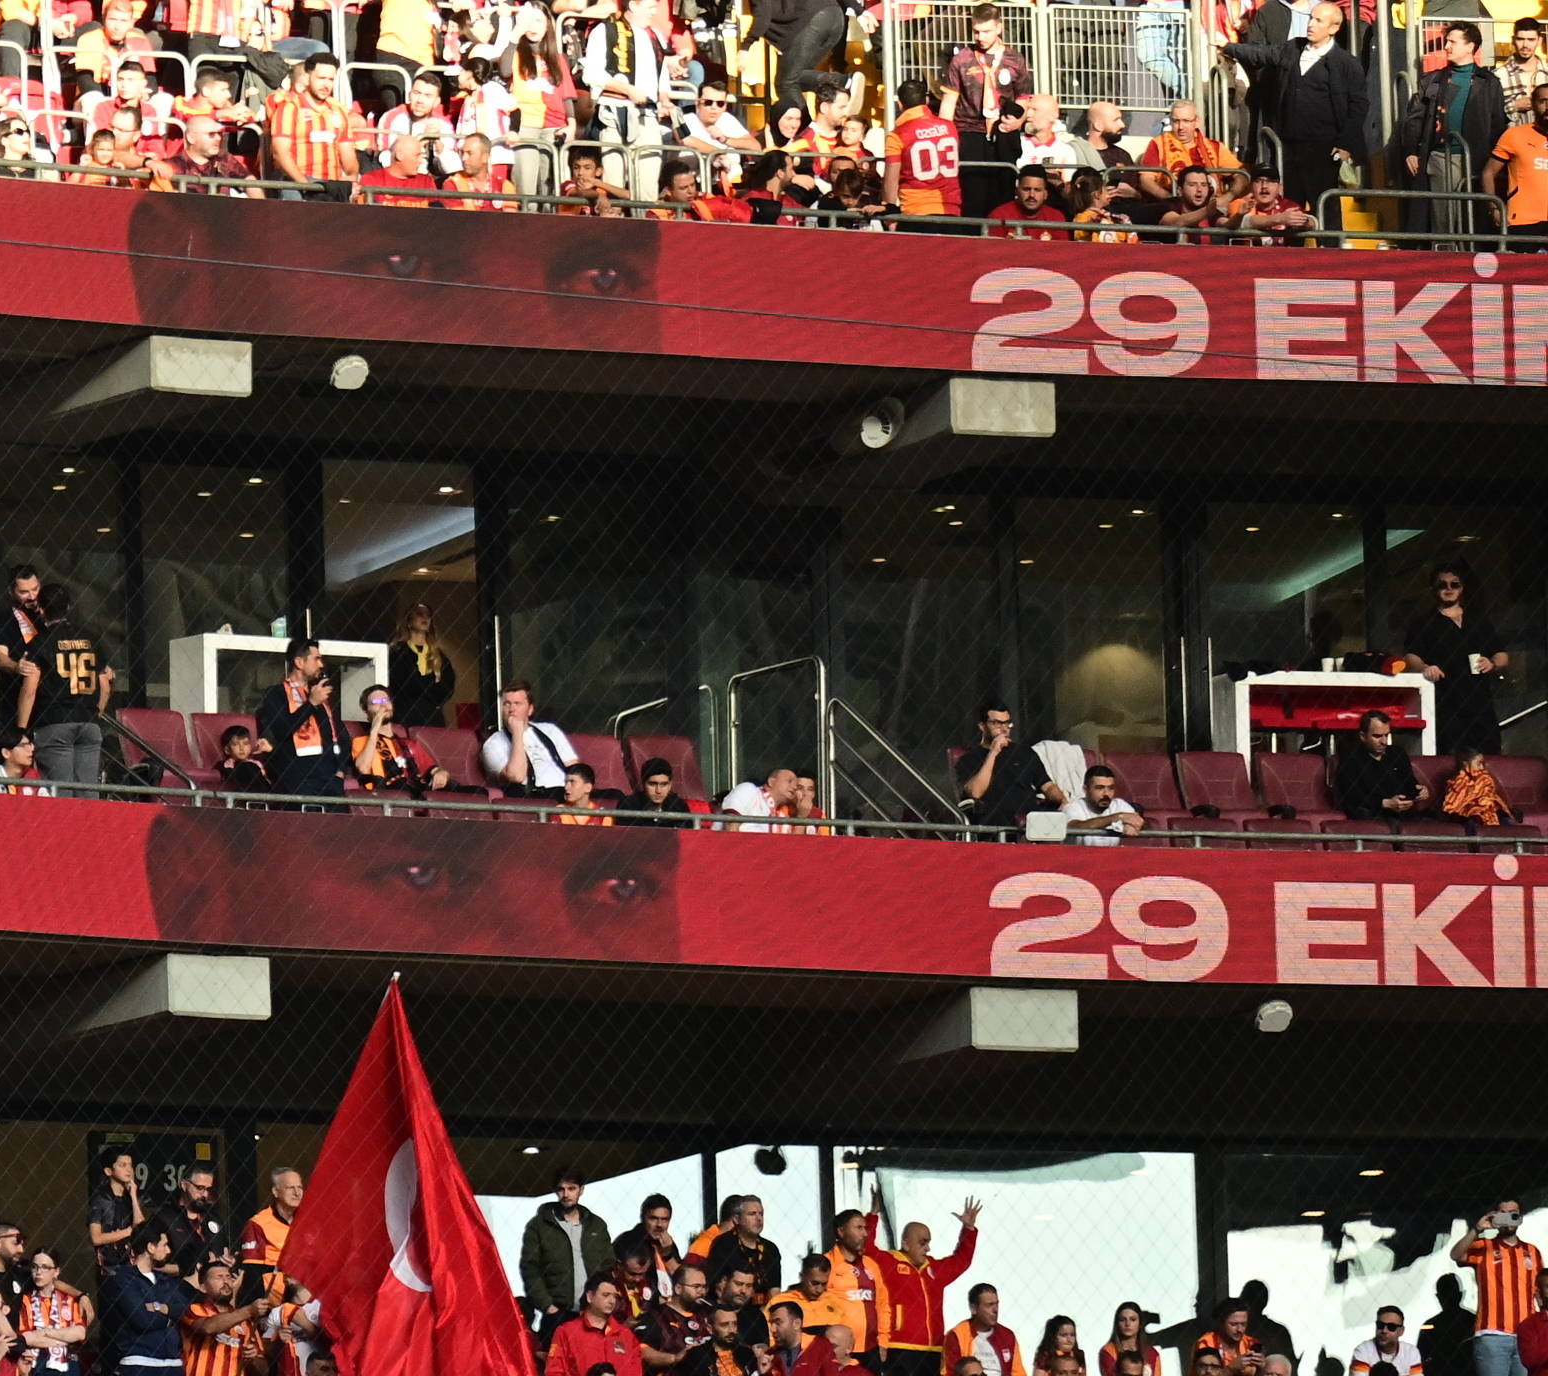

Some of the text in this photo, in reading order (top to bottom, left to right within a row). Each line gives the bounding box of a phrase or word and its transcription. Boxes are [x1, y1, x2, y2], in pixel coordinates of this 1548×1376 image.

[970, 266, 1209, 377] 29
[990, 854, 1548, 987] 29 EKİ
